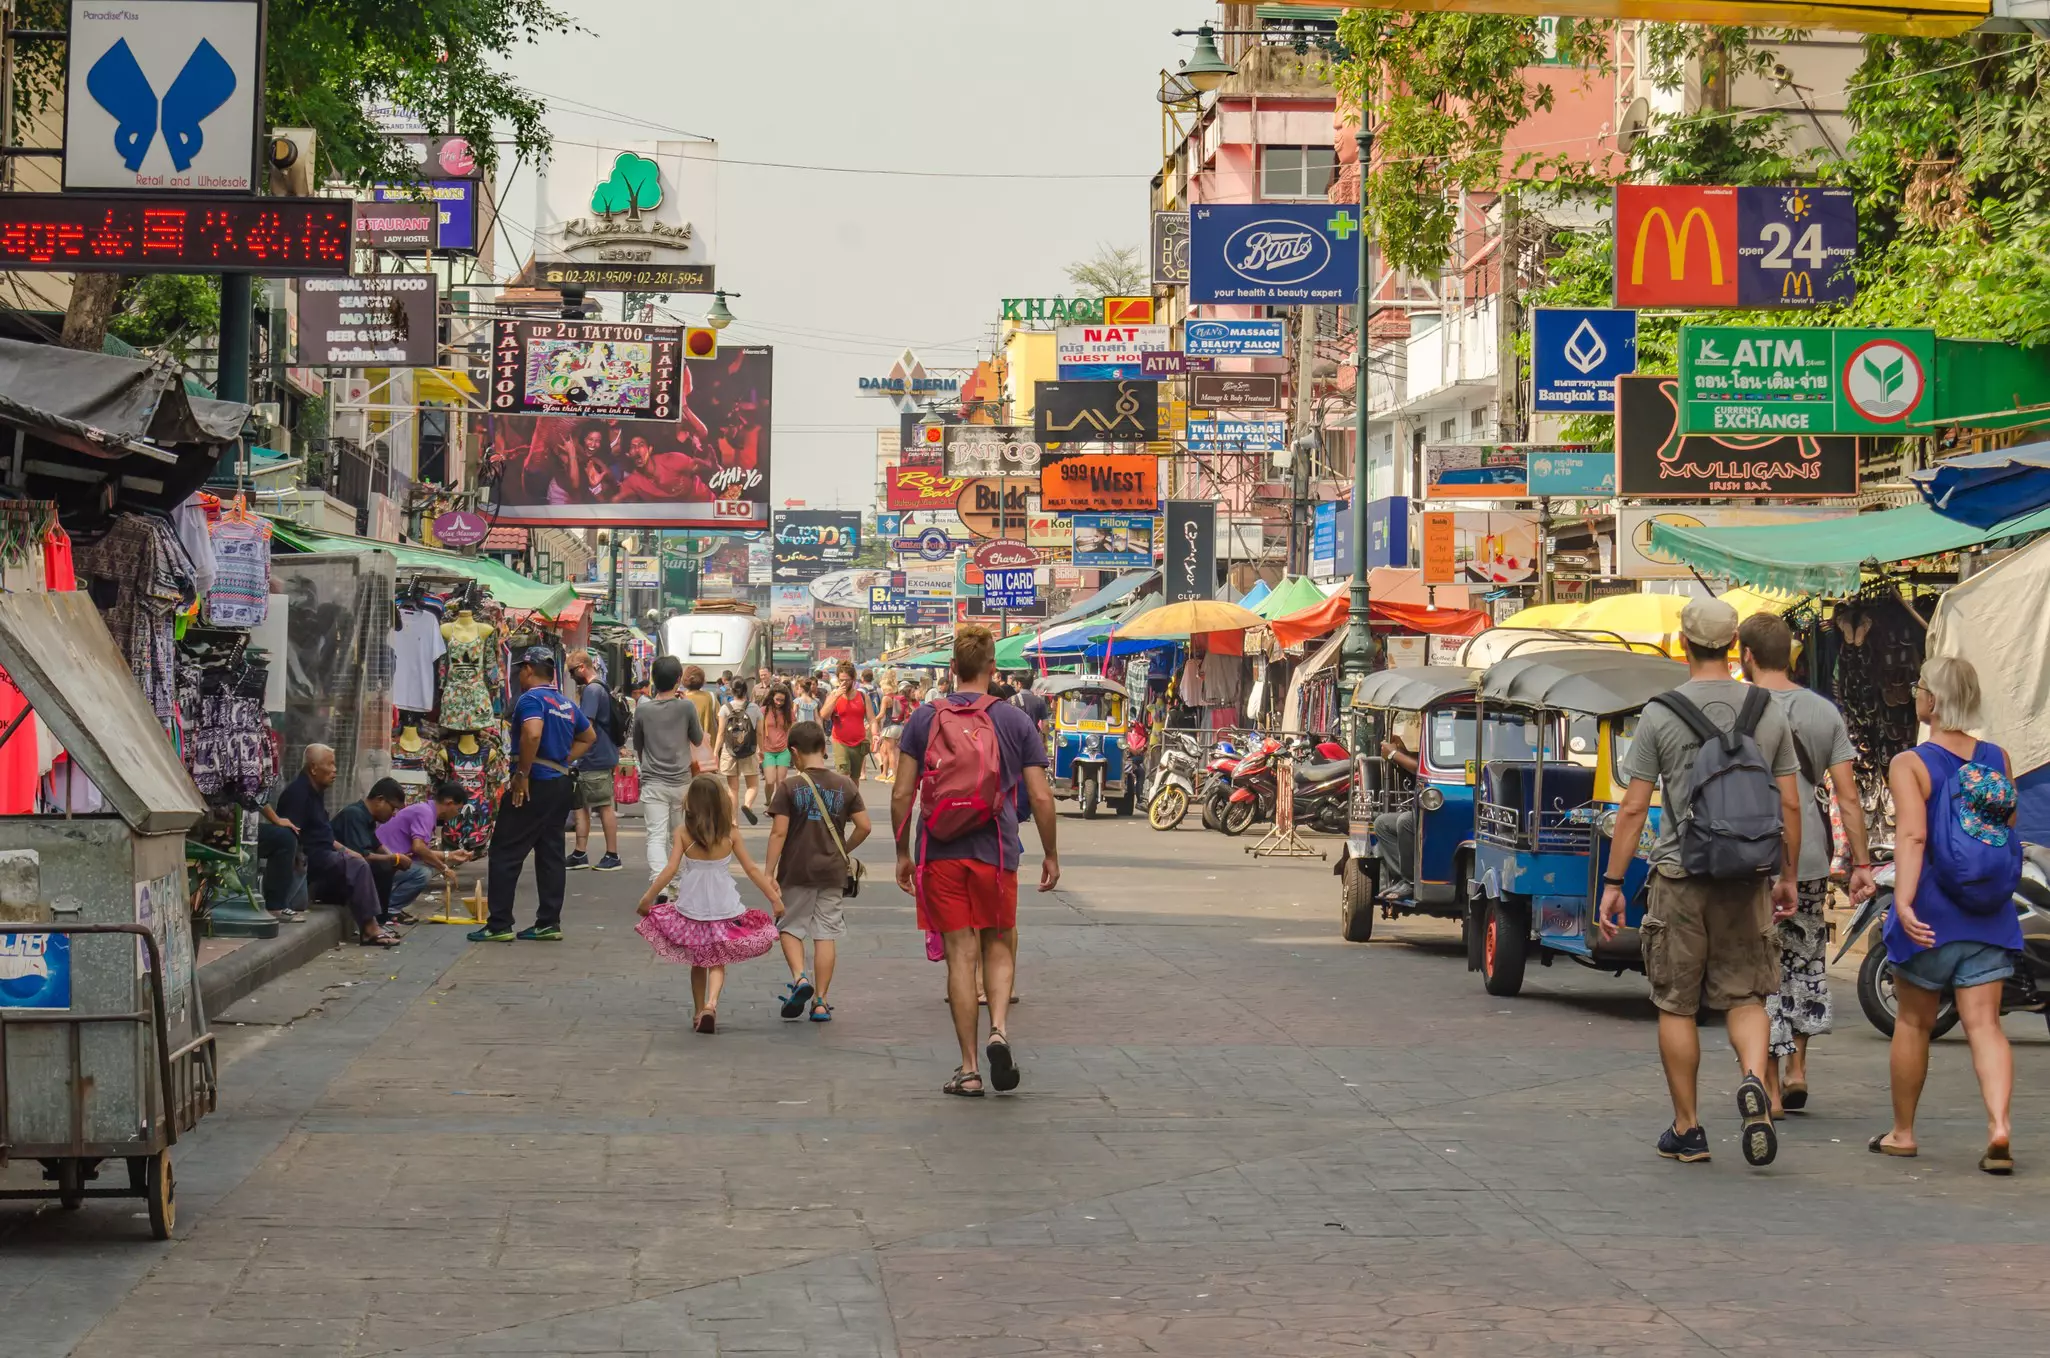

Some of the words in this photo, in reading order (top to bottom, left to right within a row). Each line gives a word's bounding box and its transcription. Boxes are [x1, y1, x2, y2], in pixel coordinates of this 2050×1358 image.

[123, 10, 139, 21] Kiss
[136, 174, 164, 186] Retail
[170, 175, 191, 187] and
[198, 176, 248, 188] Wholesale
[564, 218, 646, 240] Khaosan
[650, 220, 692, 240] Park
[1237, 231, 1312, 272] Boots
[1738, 247, 1764, 257] open
[1759, 223, 1828, 269] 24
[1827, 246, 1856, 256] hours
[598, 249, 652, 262] RESORT
[305, 279, 362, 291] ORIGINAL
[393, 279, 428, 291] FOOD
[1214, 289, 1235, 298] your
[1237, 288, 1266, 297] health
[1268, 288, 1275, 297] &
[1277, 288, 1308, 299] beauty
[1311, 288, 1342, 299] expert
[1001, 297, 1103, 321] KHAOS
[326, 330, 356, 342] BEER
[532, 326, 552, 337] UP
[582, 325, 643, 341] TATTOO
[1084, 328, 1139, 342] NAT
[1229, 328, 1280, 336] MASSAGE
[1062, 354, 1109, 362] GUEST
[1116, 354, 1142, 362] HOU
[1731, 339, 1805, 367] ATM
[496, 321, 521, 408] TATTOO
[1145, 356, 1180, 371] ATM
[656, 342, 675, 418] TATTOO
[858, 377, 905, 389] DANG
[1201, 393, 1223, 403] Massage
[1230, 394, 1243, 403] Body
[1244, 394, 1271, 402] Treatment
[1538, 389, 1595, 404] Bangkok
[1598, 389, 1615, 401] Ba
[542, 404, 560, 413] You
[562, 404, 583, 413] think
[1714, 406, 1763, 414] CURRENCY
[1714, 414, 1809, 428] EXCHANGE
[1224, 424, 1281, 433] MASSAGE
[947, 442, 1042, 466] TATTOO
[1554, 468, 1572, 476] KTB
[1659, 461, 1822, 480] MULLIGANS
[1060, 464, 1088, 482] 999
[1090, 465, 1145, 493] WEST
[918, 486, 955, 498] Bar
[1709, 481, 1741, 491] IRISH
[1744, 481, 1772, 491] BAR
[715, 501, 751, 517] LEO
[1051, 519, 1072, 528] Kod
[1099, 517, 1130, 527] Pillow
[990, 553, 1027, 565] Charlie
[663, 558, 696, 573] hang
[908, 580, 952, 589] EXCHANGE
[985, 573, 1003, 590] SIM
[1006, 572, 1033, 590] CARD
[1557, 581, 1582, 592] 7
[985, 597, 1008, 606] UNLOCK
[1016, 596, 1034, 605] PHONE
[817, 610, 853, 619] INDIAN
